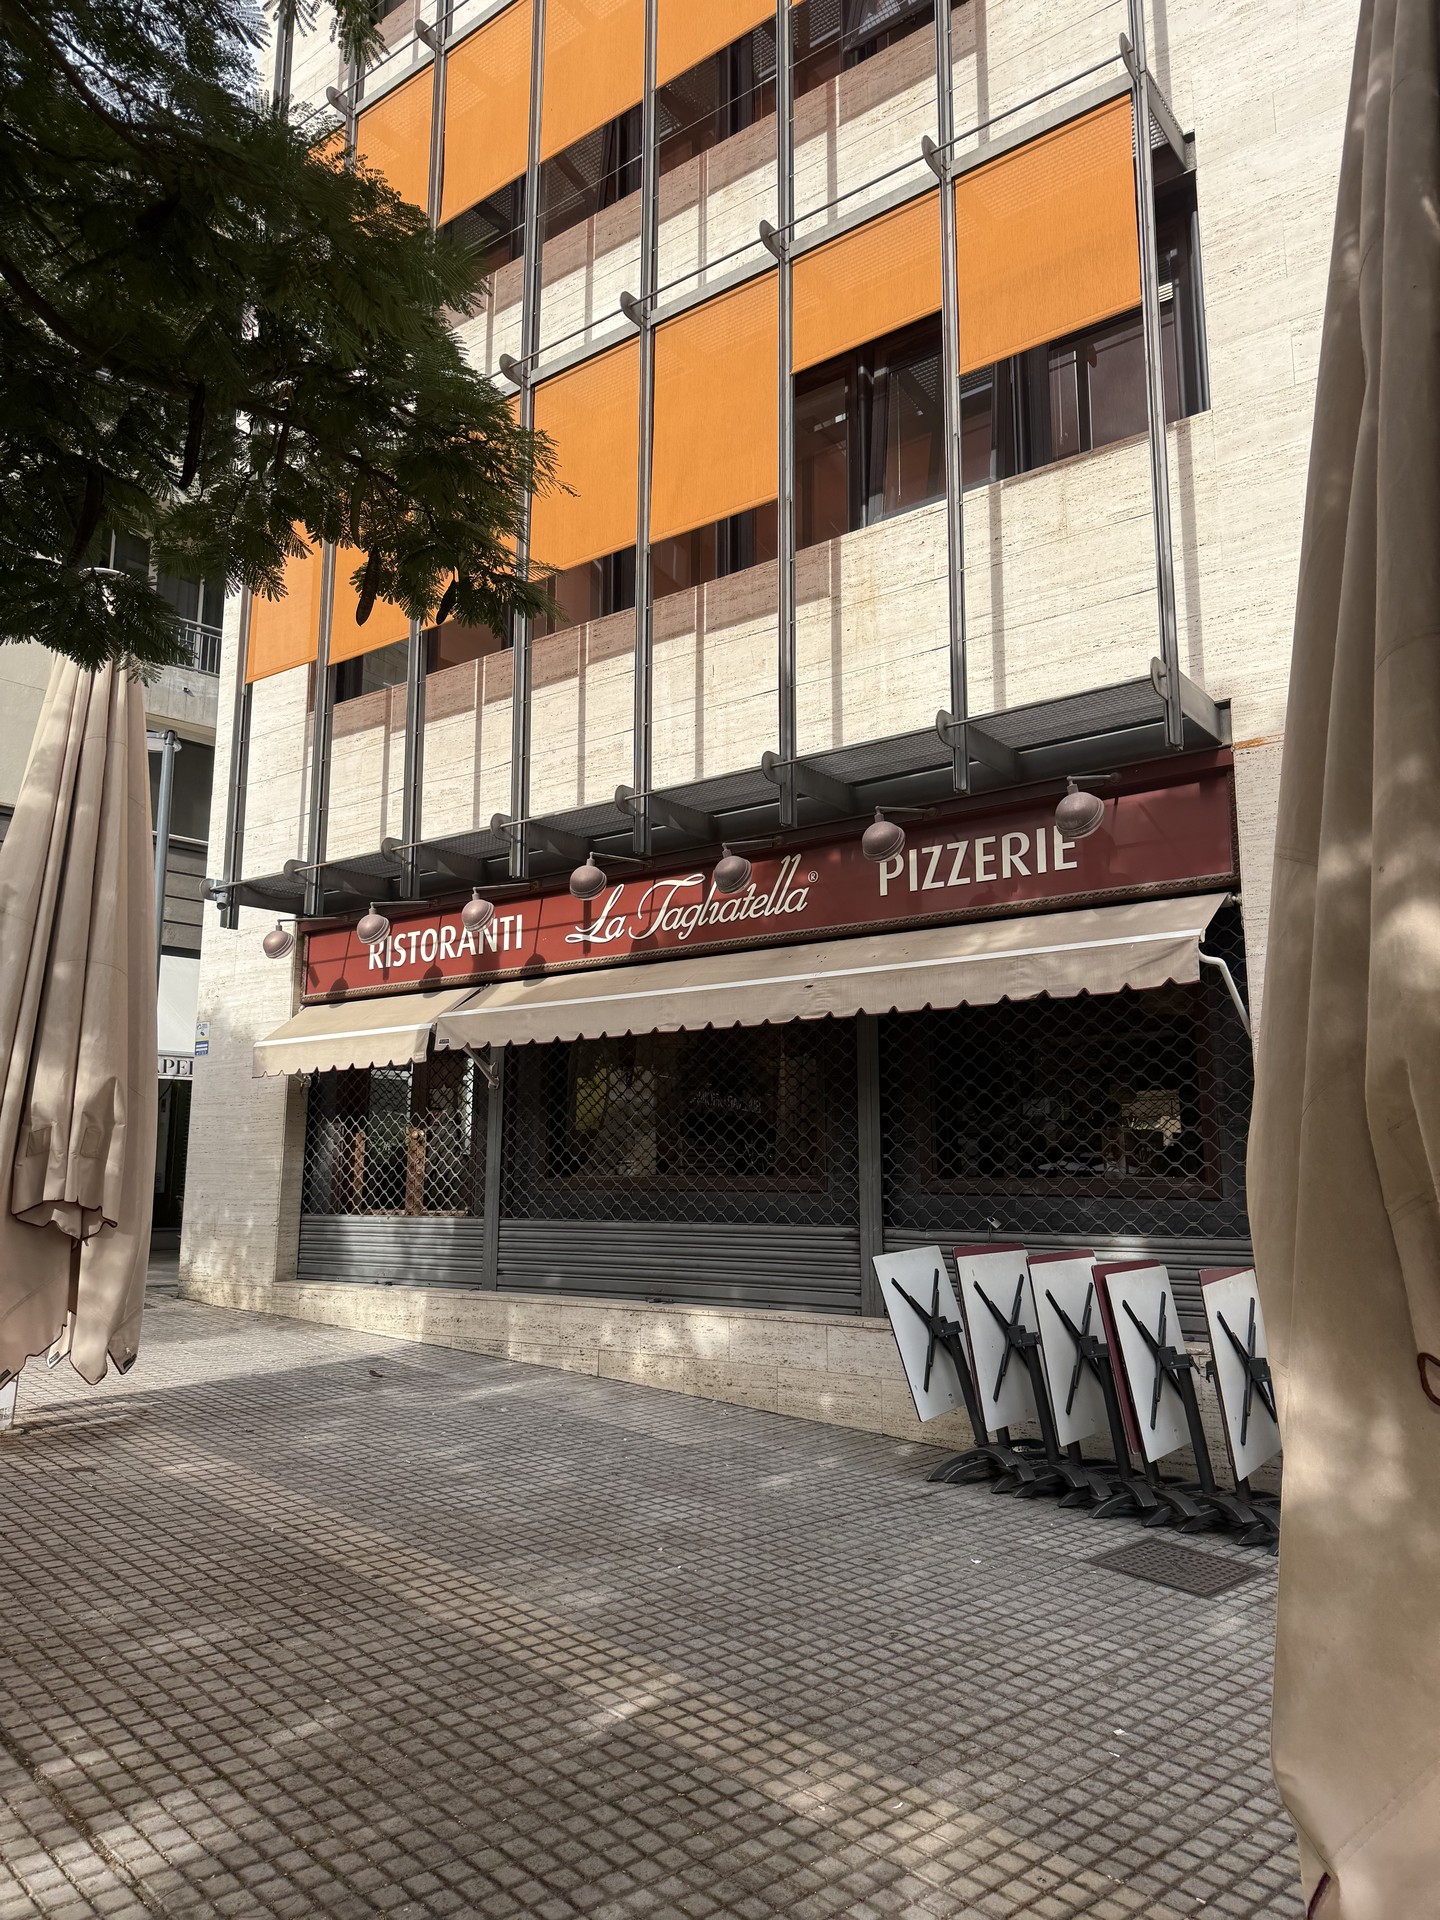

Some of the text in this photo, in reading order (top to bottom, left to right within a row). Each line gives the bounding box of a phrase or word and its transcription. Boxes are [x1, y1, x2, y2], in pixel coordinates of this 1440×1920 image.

[879, 825, 1078, 896] PIZZERIE
[368, 914, 523, 970] RISTORANTI
[565, 883, 625, 943] La
